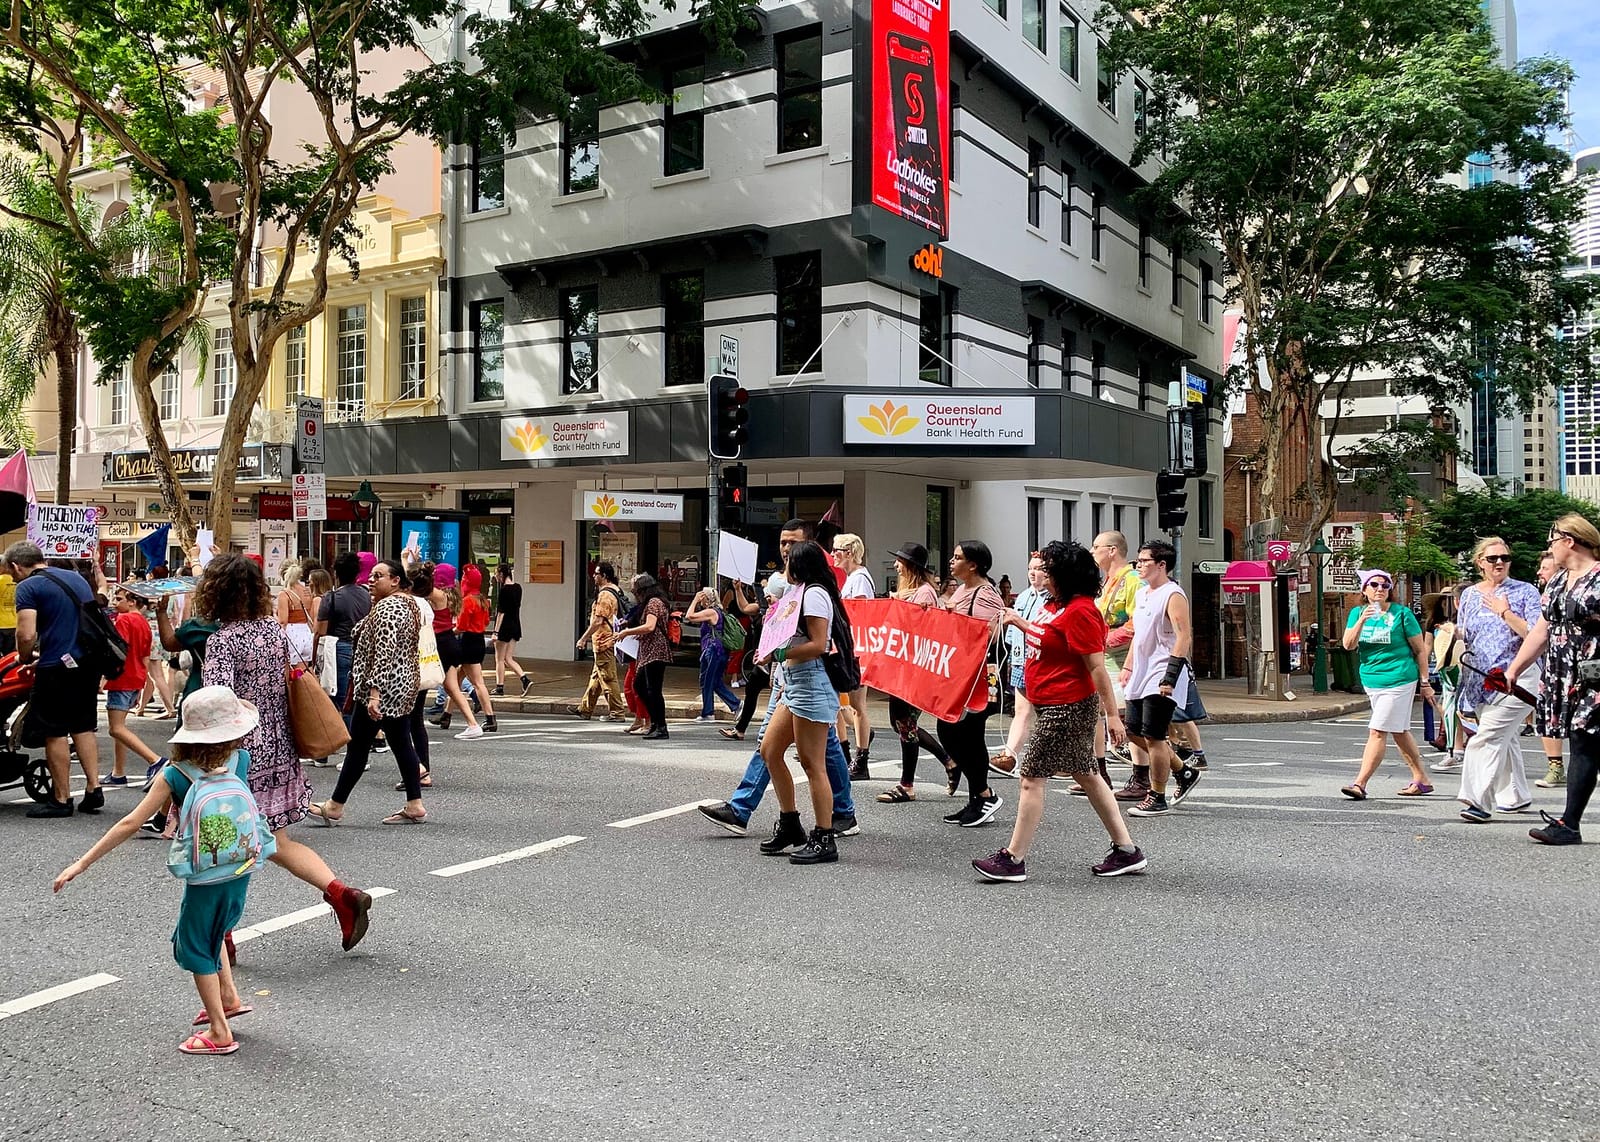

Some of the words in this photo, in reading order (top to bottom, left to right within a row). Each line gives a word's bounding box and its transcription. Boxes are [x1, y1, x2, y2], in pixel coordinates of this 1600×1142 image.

[886, 149, 937, 194] Ladbrokes
[722, 339, 736, 353] ONE
[722, 353, 737, 366] WAY
[926, 403, 1002, 417] Queensland
[307, 421, 314, 435] C
[553, 419, 605, 432] Queensland
[926, 415, 978, 429] Country
[553, 431, 588, 443] Country
[926, 428, 952, 438] Bank
[959, 428, 995, 438] Health
[998, 429, 1024, 438] Fund
[553, 443, 571, 452] Bank
[575, 440, 601, 451] Health
[602, 440, 621, 450] Fund
[298, 475, 304, 484] C
[621, 498, 655, 509] Queensland
[655, 500, 678, 511] Country
[37, 506, 86, 523] MISOGYNY
[621, 507, 634, 515] Bank
[41, 522, 59, 532] HAS
[60, 523, 74, 532] NO
[108, 525, 129, 536] Casket
[46, 534, 64, 543] TAKE
[64, 535, 88, 544] ACTION
[424, 551, 447, 560] EASY
